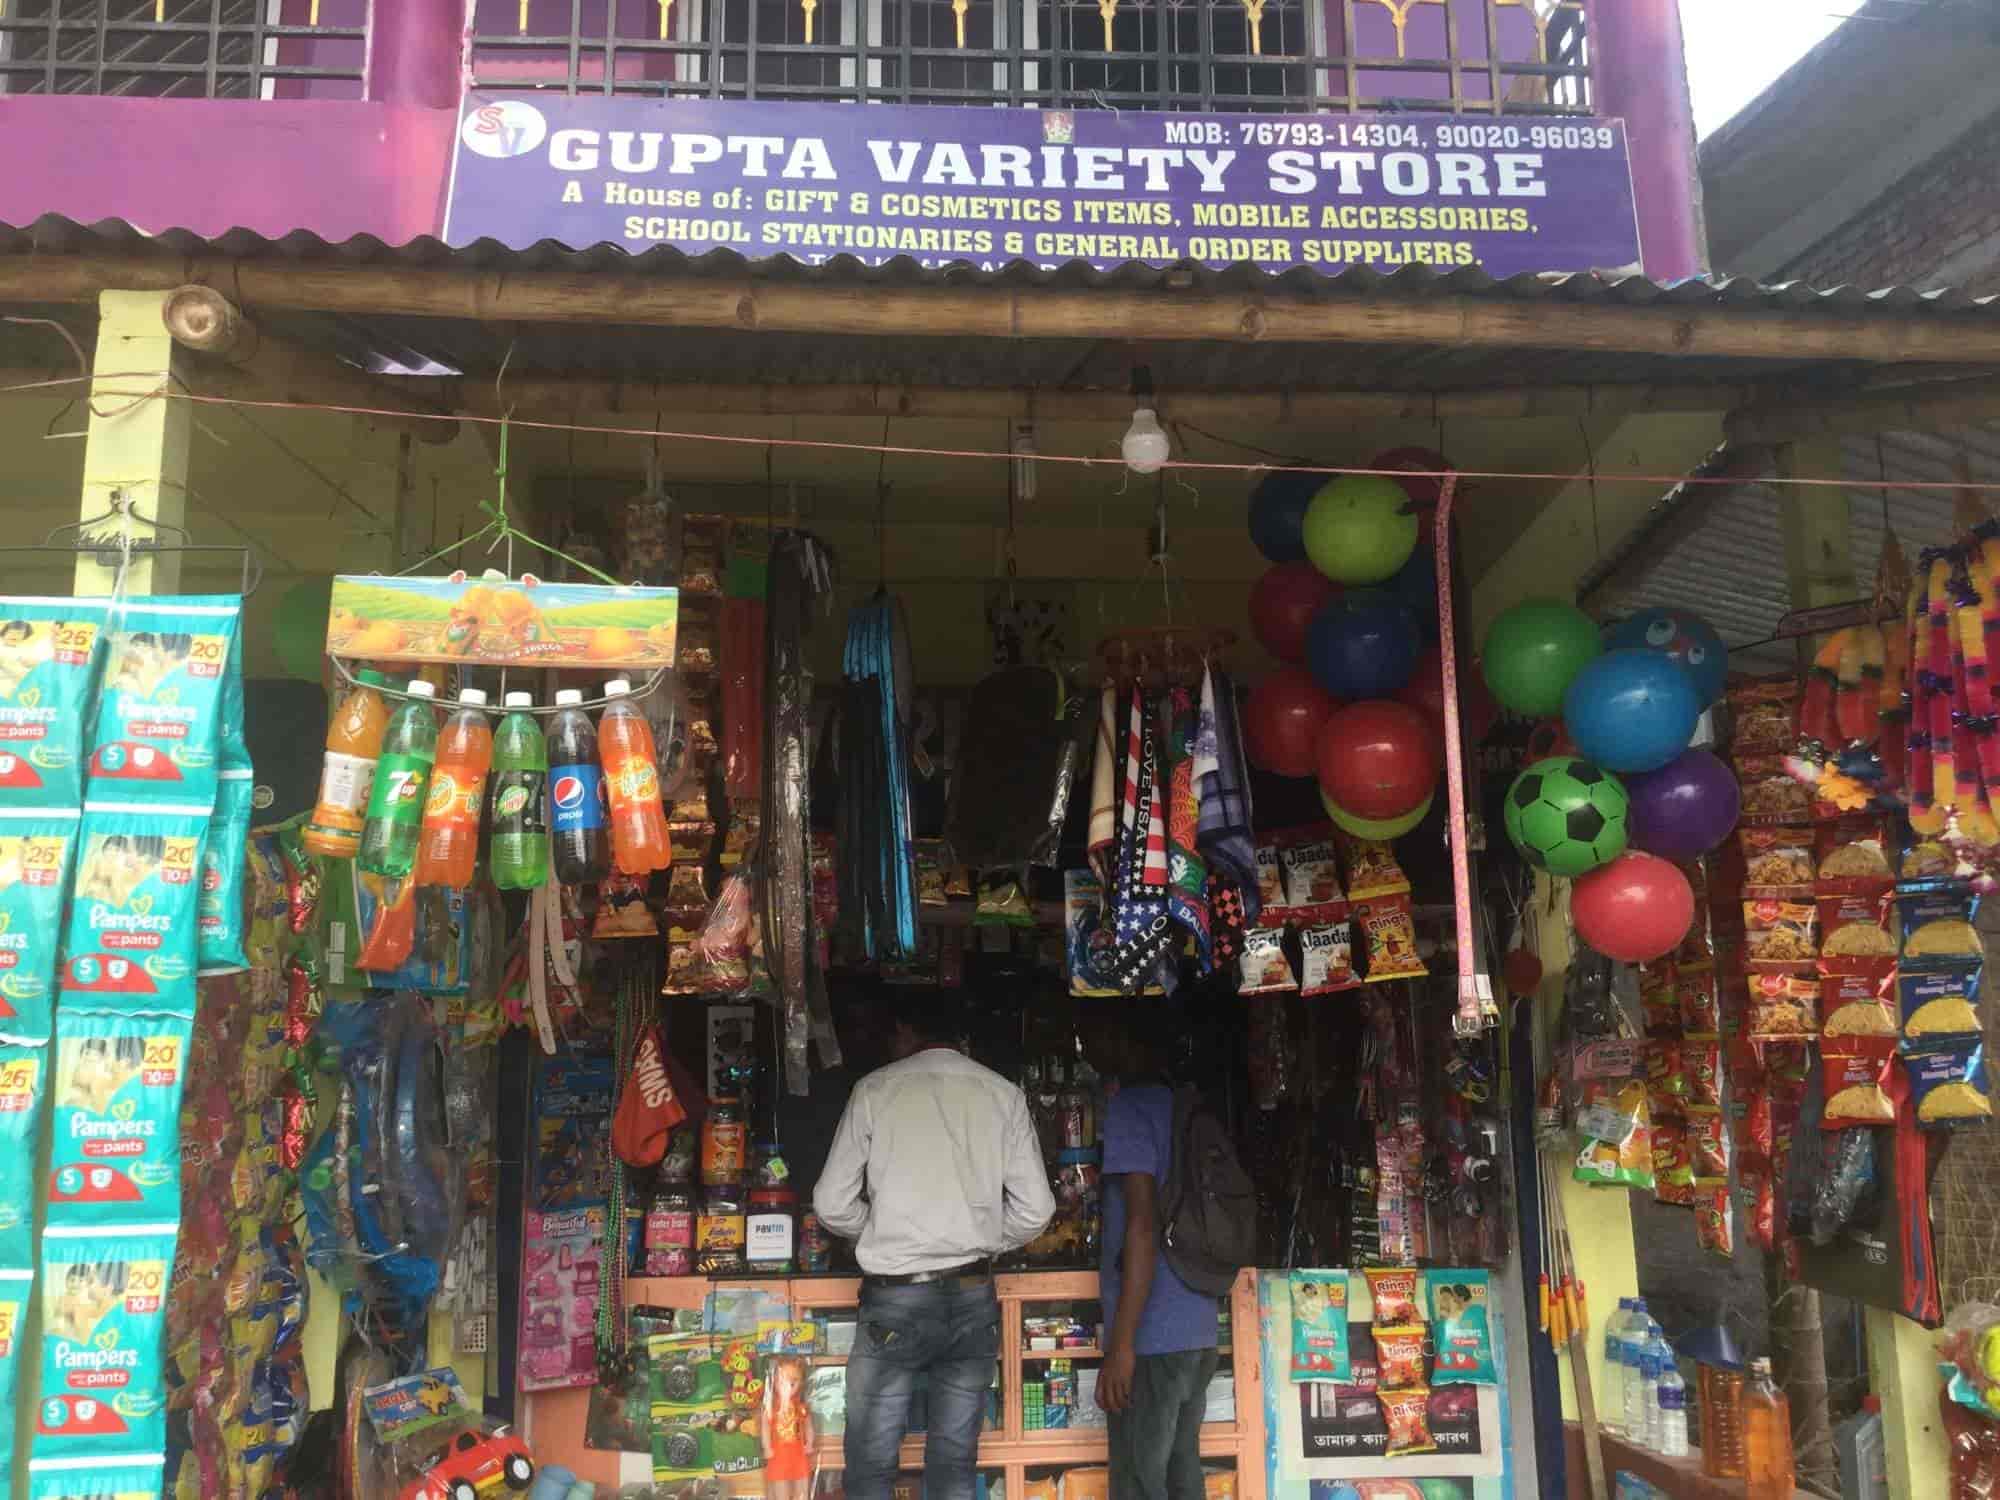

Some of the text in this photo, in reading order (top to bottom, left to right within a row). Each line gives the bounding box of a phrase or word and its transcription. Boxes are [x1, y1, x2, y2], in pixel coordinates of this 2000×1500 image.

[1164, 121, 1614, 149] MOB: 76793-14304, 90020-96039
[548, 129, 1548, 197] GUPTA VARIETY STORE
[561, 180, 1539, 233] A House of: GIFT & COSMETICS ITEMS, MOBILE ACCESSORIES,
[624, 216, 1483, 266] SCHOOL STATIONARIES & GENERAL ORDER SUPPLIERS.
[1135, 795, 1153, 841] USA
[89, 903, 171, 934] Pampers
[1367, 913, 1408, 930] Rings
[120, 934, 159, 947] pants
[1304, 928, 1353, 950] Jaadu
[146, 1046, 174, 1063] 20
[71, 1111, 155, 1141] Pampers
[103, 1140, 144, 1153] pants
[63, 1169, 75, 1185] S
[131, 1272, 159, 1289] 20
[55, 1341, 138, 1372] Pampers
[87, 1375, 126, 1388] pants
